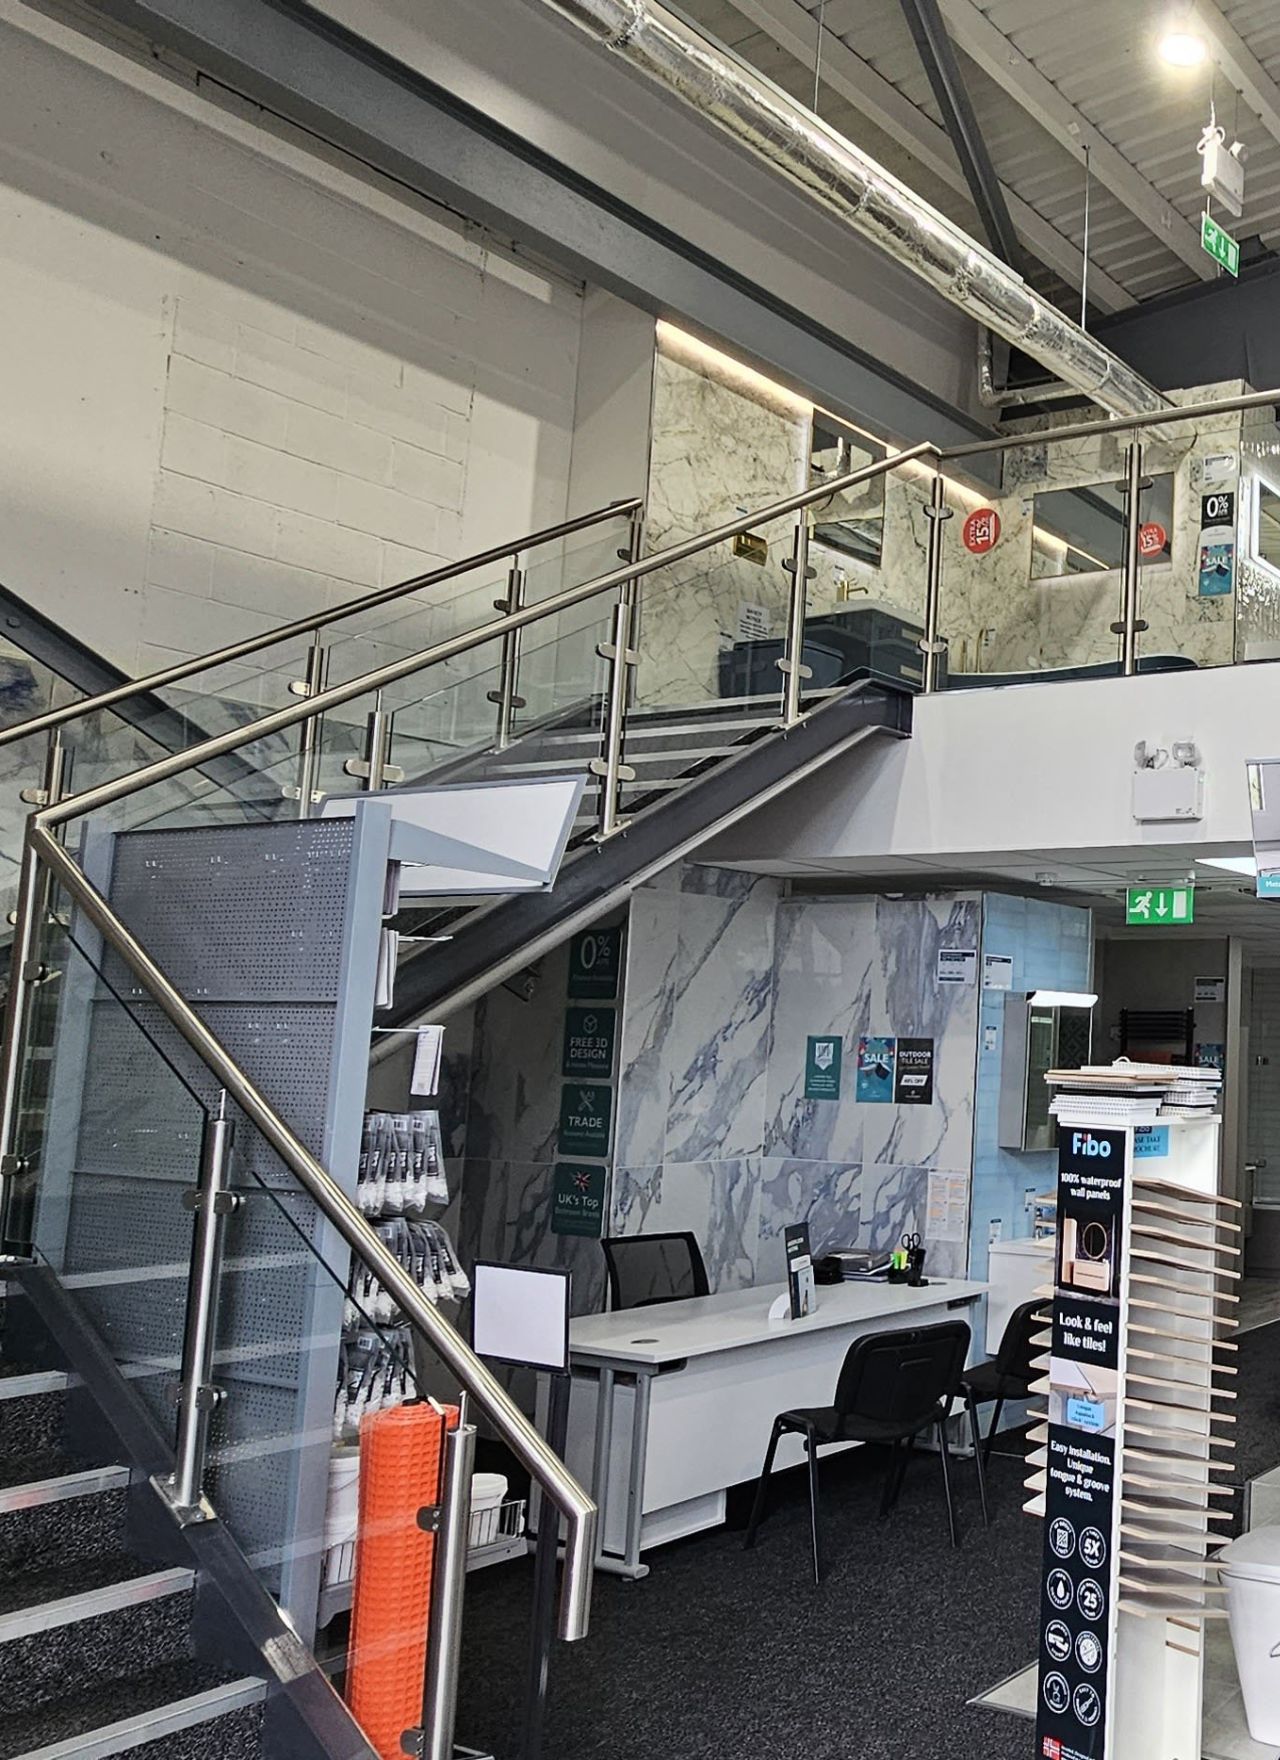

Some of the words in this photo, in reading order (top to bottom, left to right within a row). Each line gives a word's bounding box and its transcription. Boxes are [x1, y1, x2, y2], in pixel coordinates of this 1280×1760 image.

[570, 1036, 594, 1048] FREE
[570, 1048, 606, 1059] DESIGN
[864, 1052, 889, 1063] SALE
[899, 1050, 932, 1058] OUTDOOR
[568, 1115, 603, 1128] TRADE
[1072, 1132, 1111, 1158] Fibo
[1061, 1172, 1080, 1183] 100%
[1080, 1176, 1122, 1189] waterproof
[558, 1193, 580, 1206] UK's
[581, 1195, 599, 1210] Top
[1070, 1187, 1086, 1198] wall
[1086, 1190, 1111, 1201] panels
[1060, 1312, 1083, 1329] Look
[1084, 1317, 1092, 1330] &
[1093, 1319, 1113, 1335] feel
[1063, 1331, 1081, 1347] like
[1082, 1336, 1106, 1352] tiles!
[1050, 1440, 1068, 1456] Easy
[1067, 1457, 1094, 1474] Unique
[1050, 1467, 1076, 1483] tongue
[1076, 1473, 1082, 1485] &
[1083, 1478, 1110, 1493] groove
[1065, 1486, 1094, 1502] system.
[1083, 1538, 1101, 1557] 5X
[1083, 1590, 1098, 1609] 25
